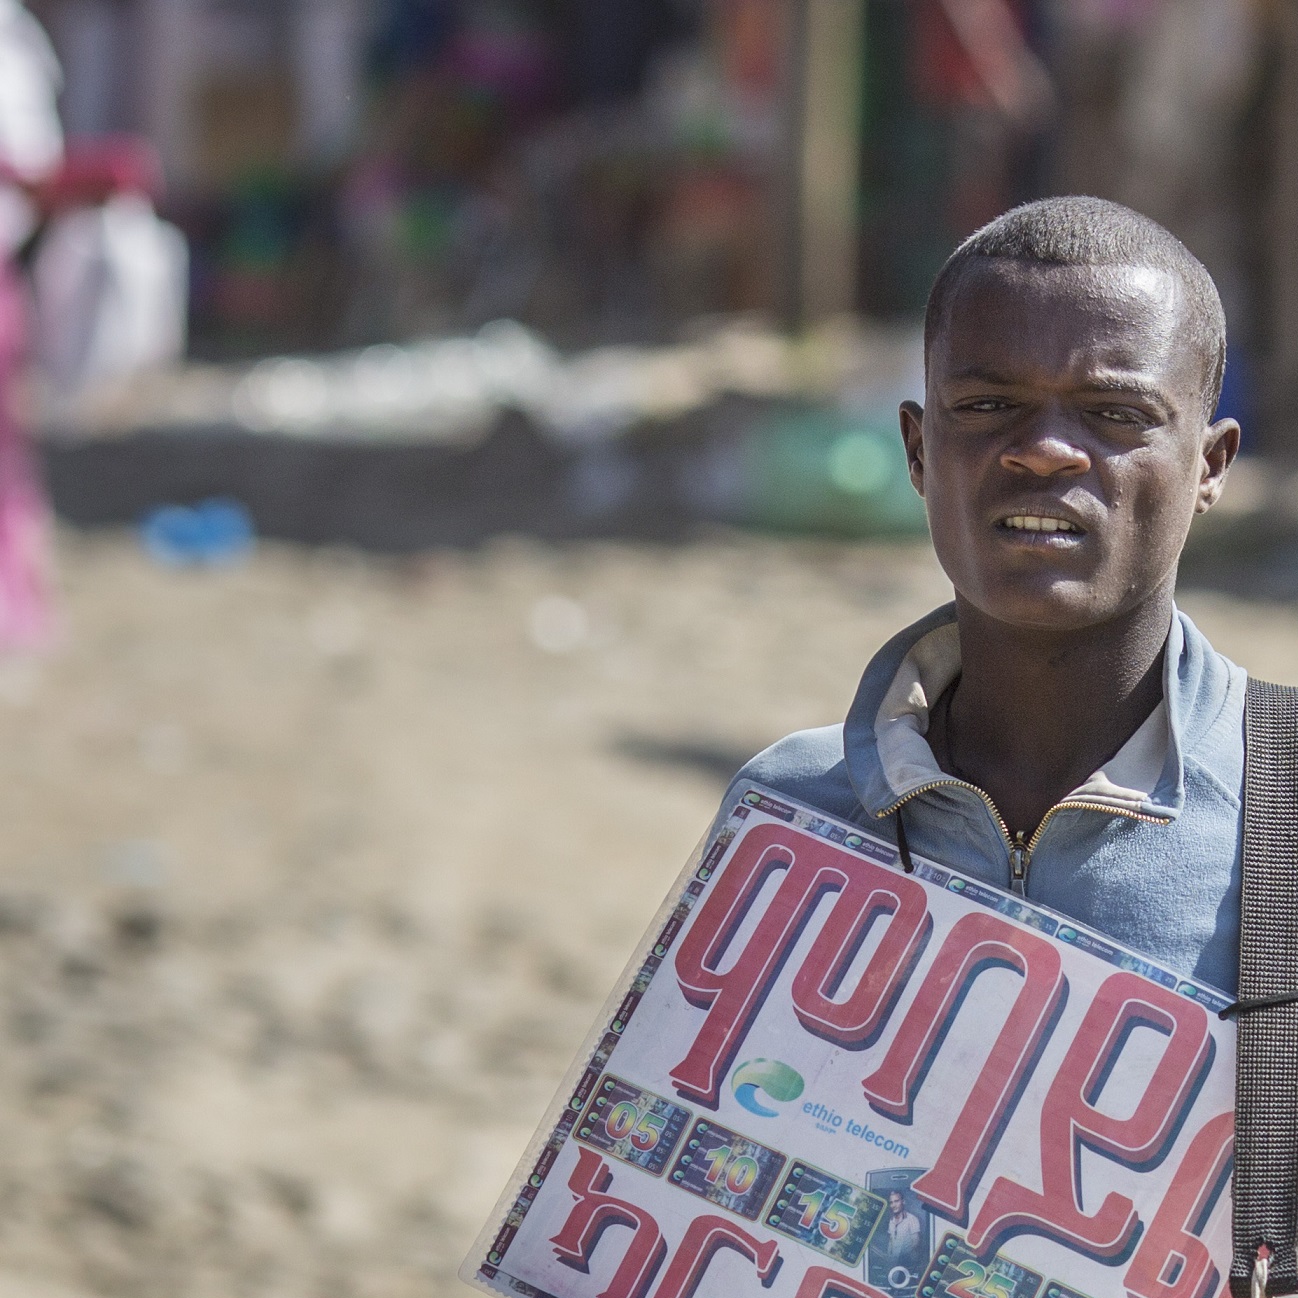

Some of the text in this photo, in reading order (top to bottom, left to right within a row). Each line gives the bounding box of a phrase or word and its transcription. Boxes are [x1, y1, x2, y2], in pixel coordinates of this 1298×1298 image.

[604, 1100, 669, 1153] 05
[803, 1101, 843, 1127] ethio
[845, 1118, 910, 1159] telecom
[703, 1146, 761, 1197] 10
[799, 1189, 857, 1241] 15
